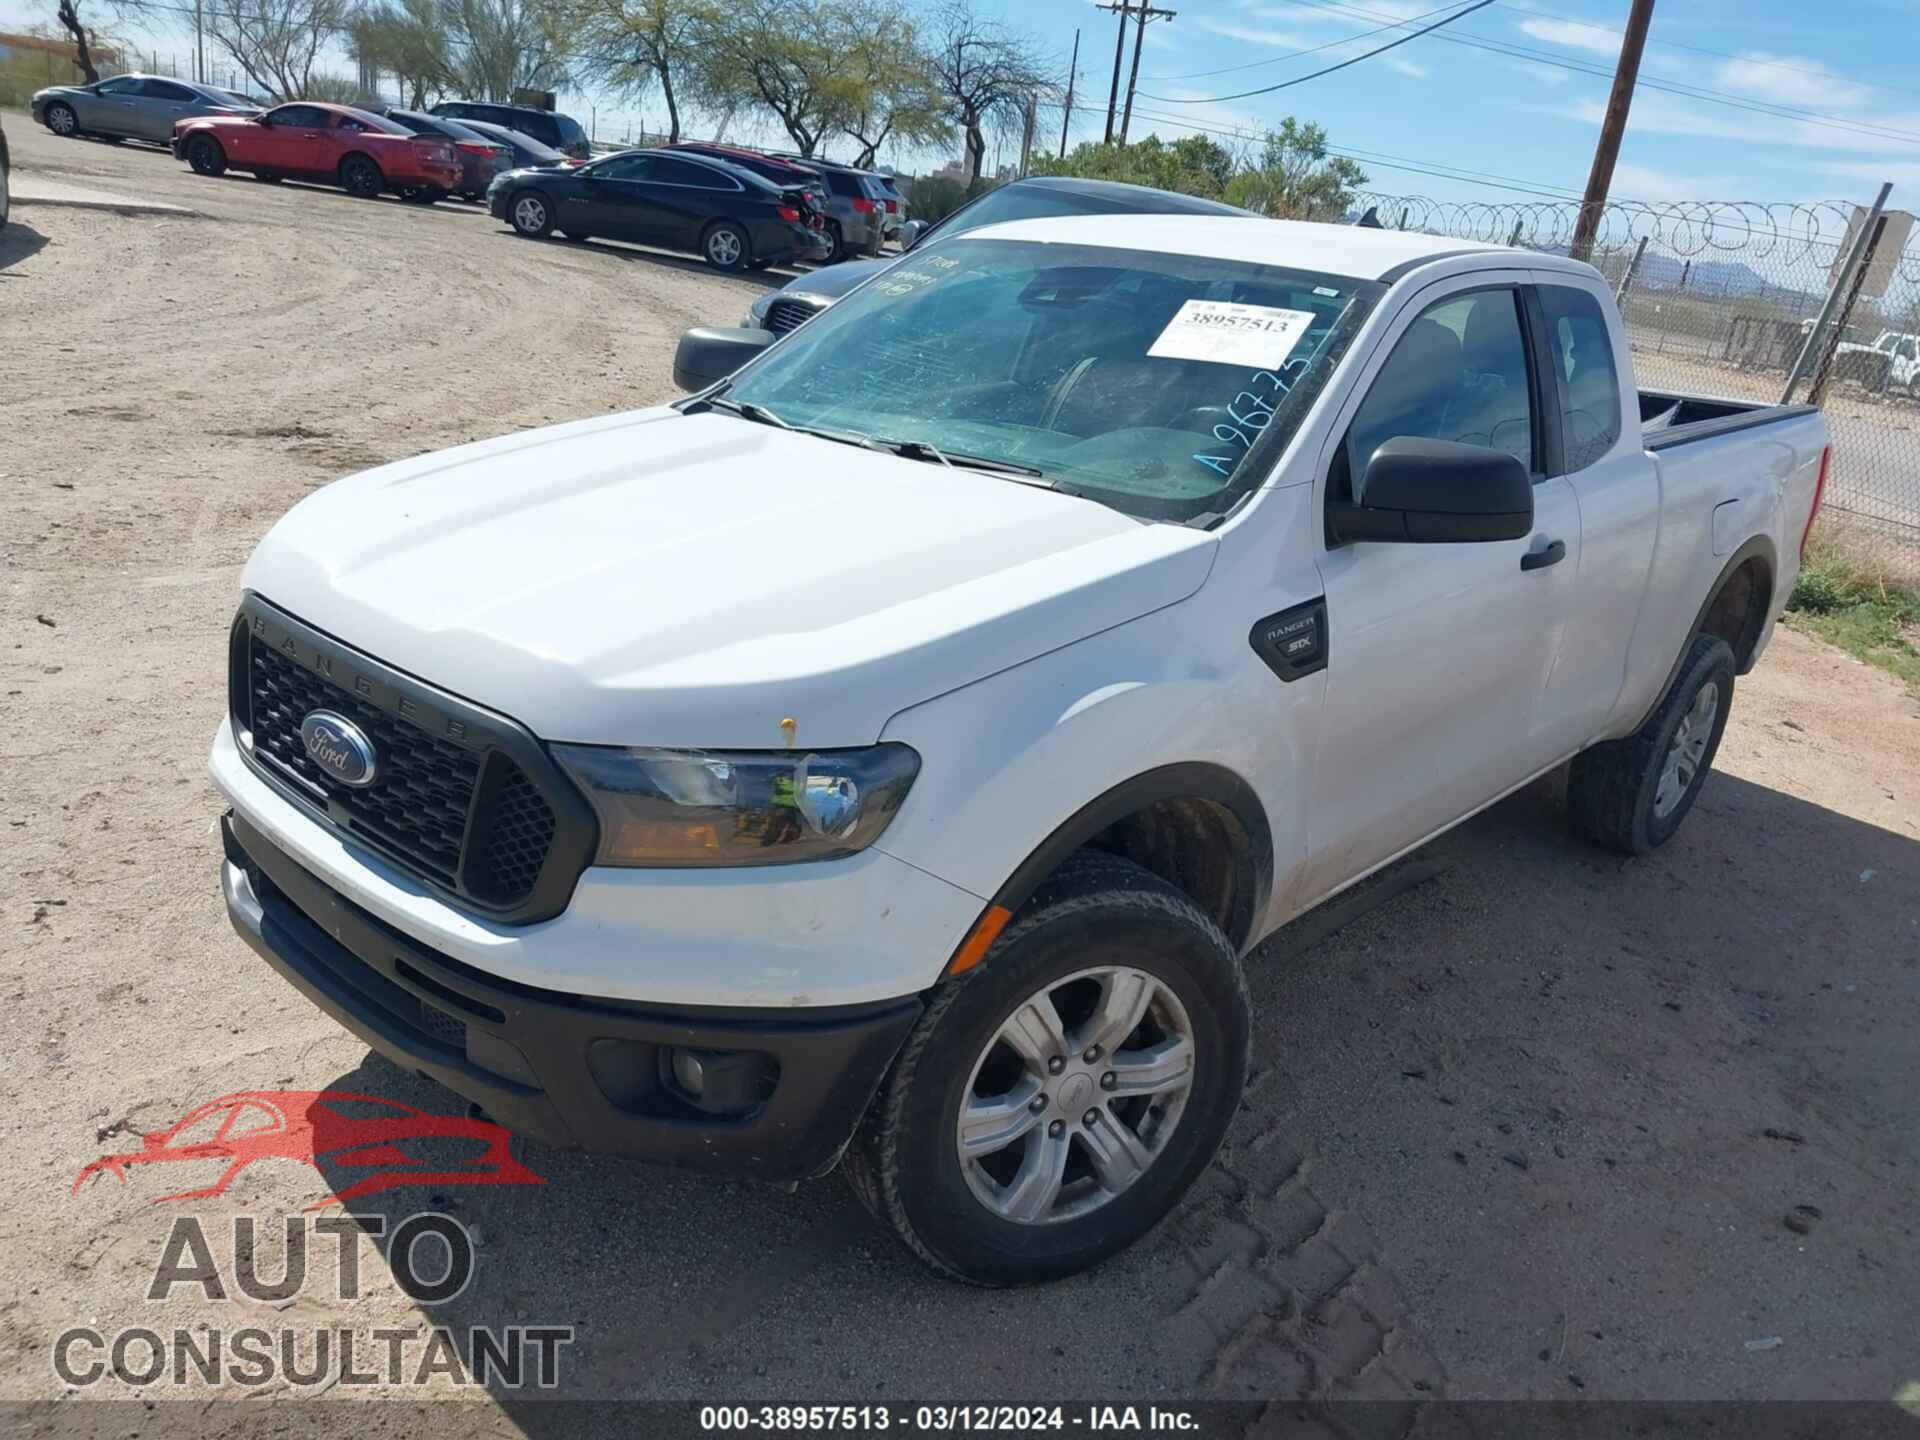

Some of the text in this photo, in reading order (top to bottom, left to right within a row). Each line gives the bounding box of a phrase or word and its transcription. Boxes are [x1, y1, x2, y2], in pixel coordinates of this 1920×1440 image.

[1186, 312, 1289, 334] 38957513
[1267, 616, 1315, 641] RANGER
[1287, 635, 1312, 653] STX
[253, 616, 469, 742] RANGER
[310, 726, 349, 770] Ford
